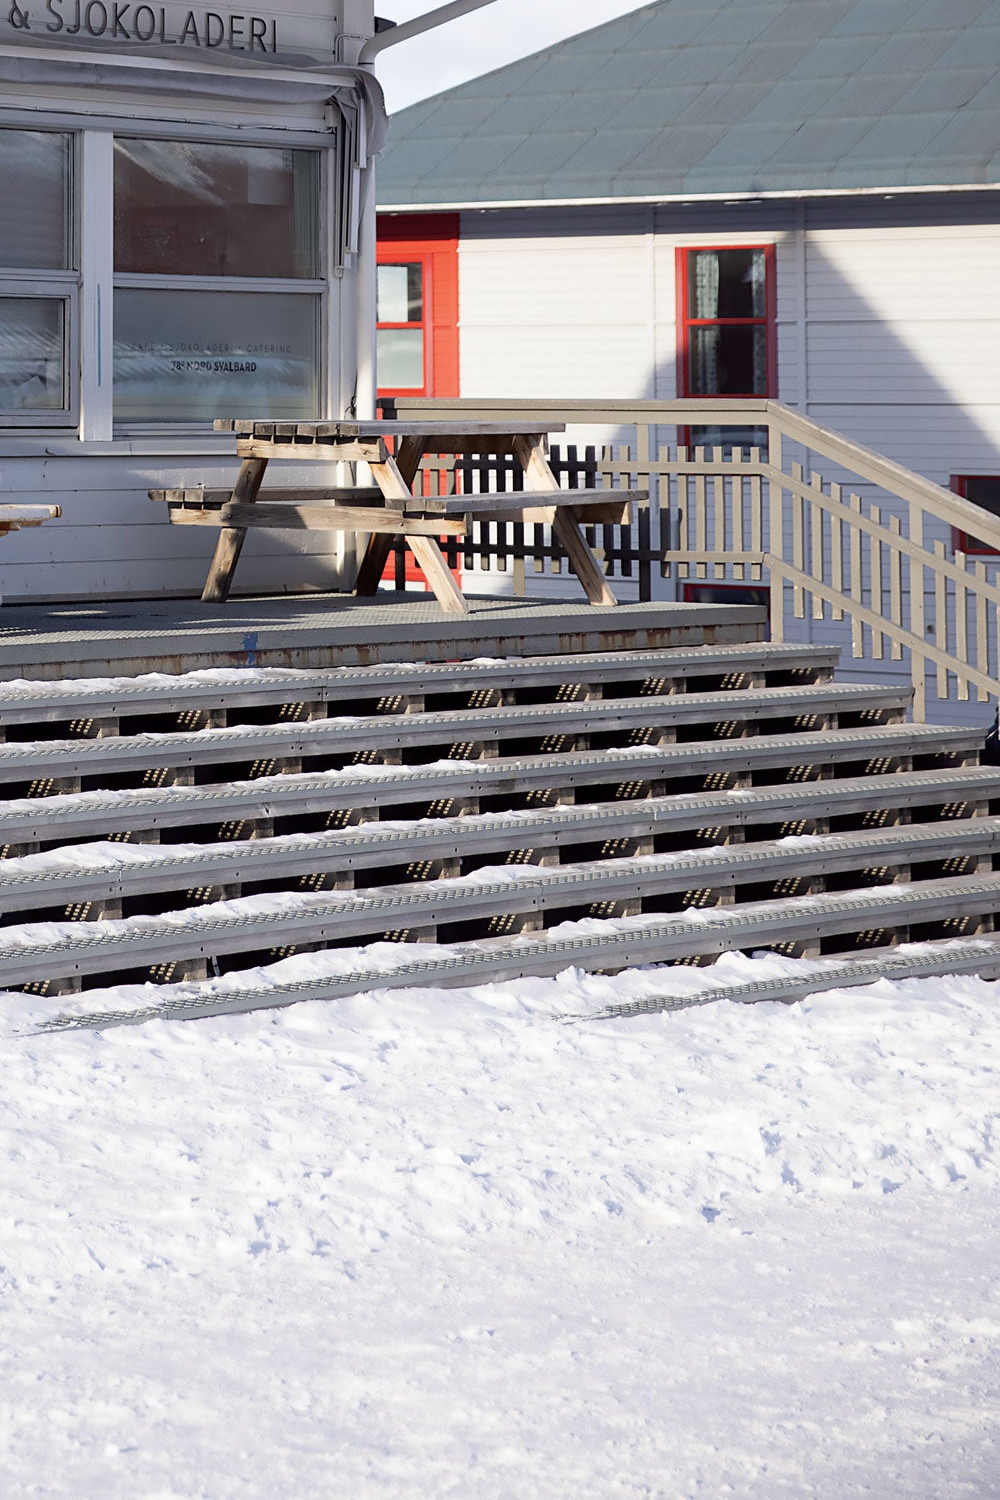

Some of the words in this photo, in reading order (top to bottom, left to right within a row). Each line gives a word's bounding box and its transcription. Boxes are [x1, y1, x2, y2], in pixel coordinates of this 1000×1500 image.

[246, 343, 292, 354] CATERING
[186, 361, 212, 372] NORD
[213, 361, 257, 373] SVALBARD
